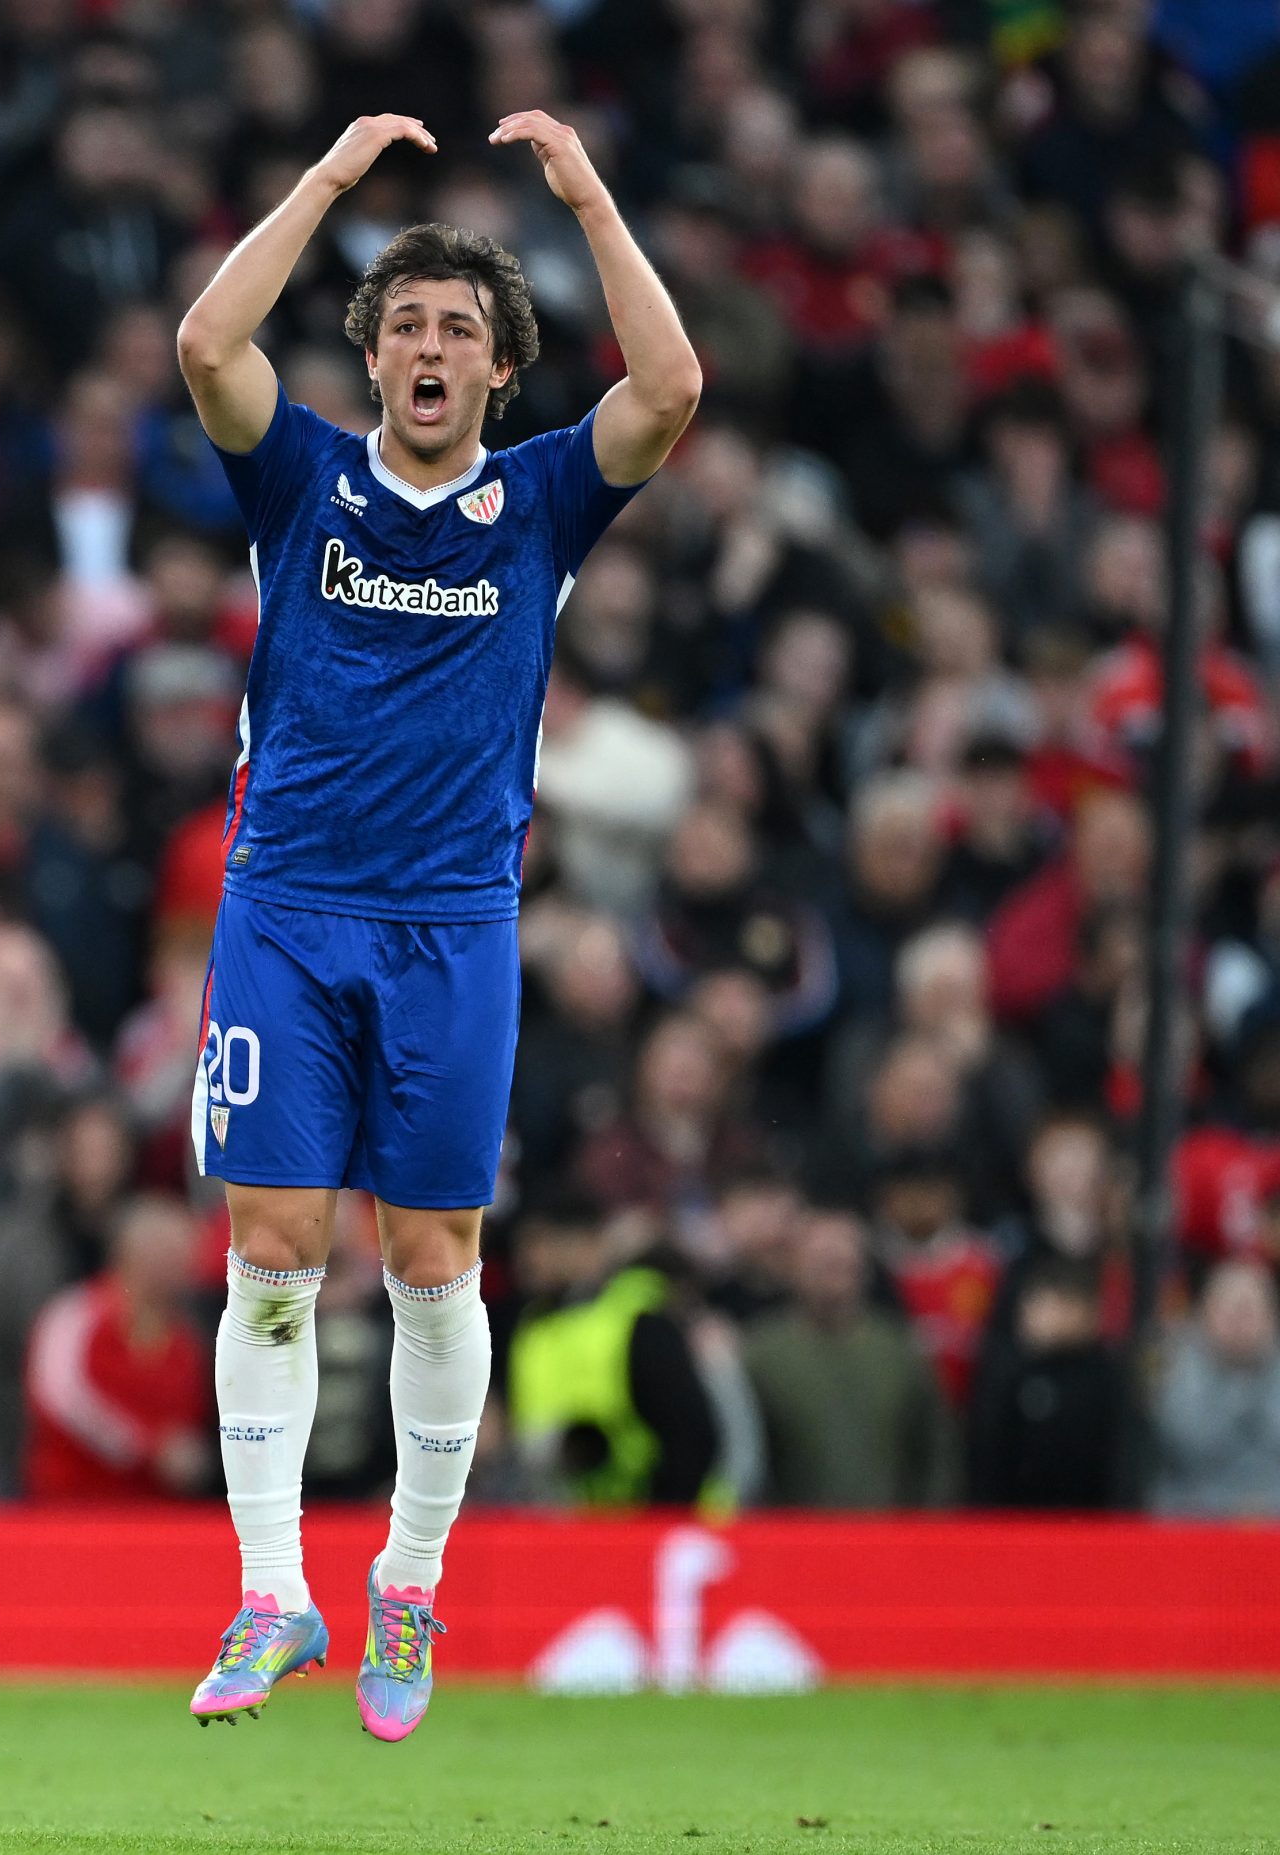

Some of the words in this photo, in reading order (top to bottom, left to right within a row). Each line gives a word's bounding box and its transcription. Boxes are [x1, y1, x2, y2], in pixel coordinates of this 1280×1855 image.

[330, 495, 364, 517] CASTORE
[324, 541, 498, 614] Kutxabank
[207, 1019, 261, 1106] 20
[226, 1434, 266, 1442] CLUB
[408, 1431, 475, 1446] ATHLETIC
[421, 1444, 462, 1453] CLUB
